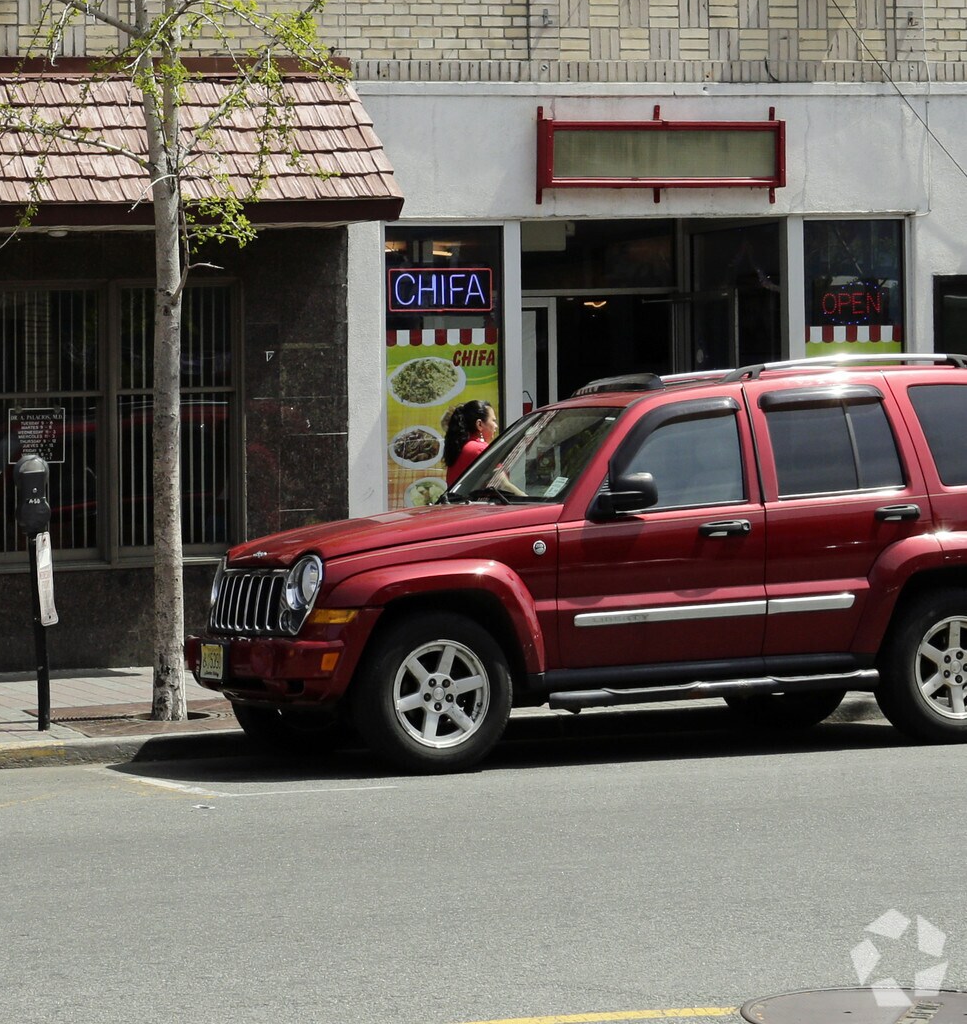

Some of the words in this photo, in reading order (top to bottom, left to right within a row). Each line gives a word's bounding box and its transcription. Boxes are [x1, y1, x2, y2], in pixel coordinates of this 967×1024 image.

[395, 273, 486, 306] CHIFA
[822, 292, 881, 315] OPEN
[453, 349, 495, 367] CHIFA
